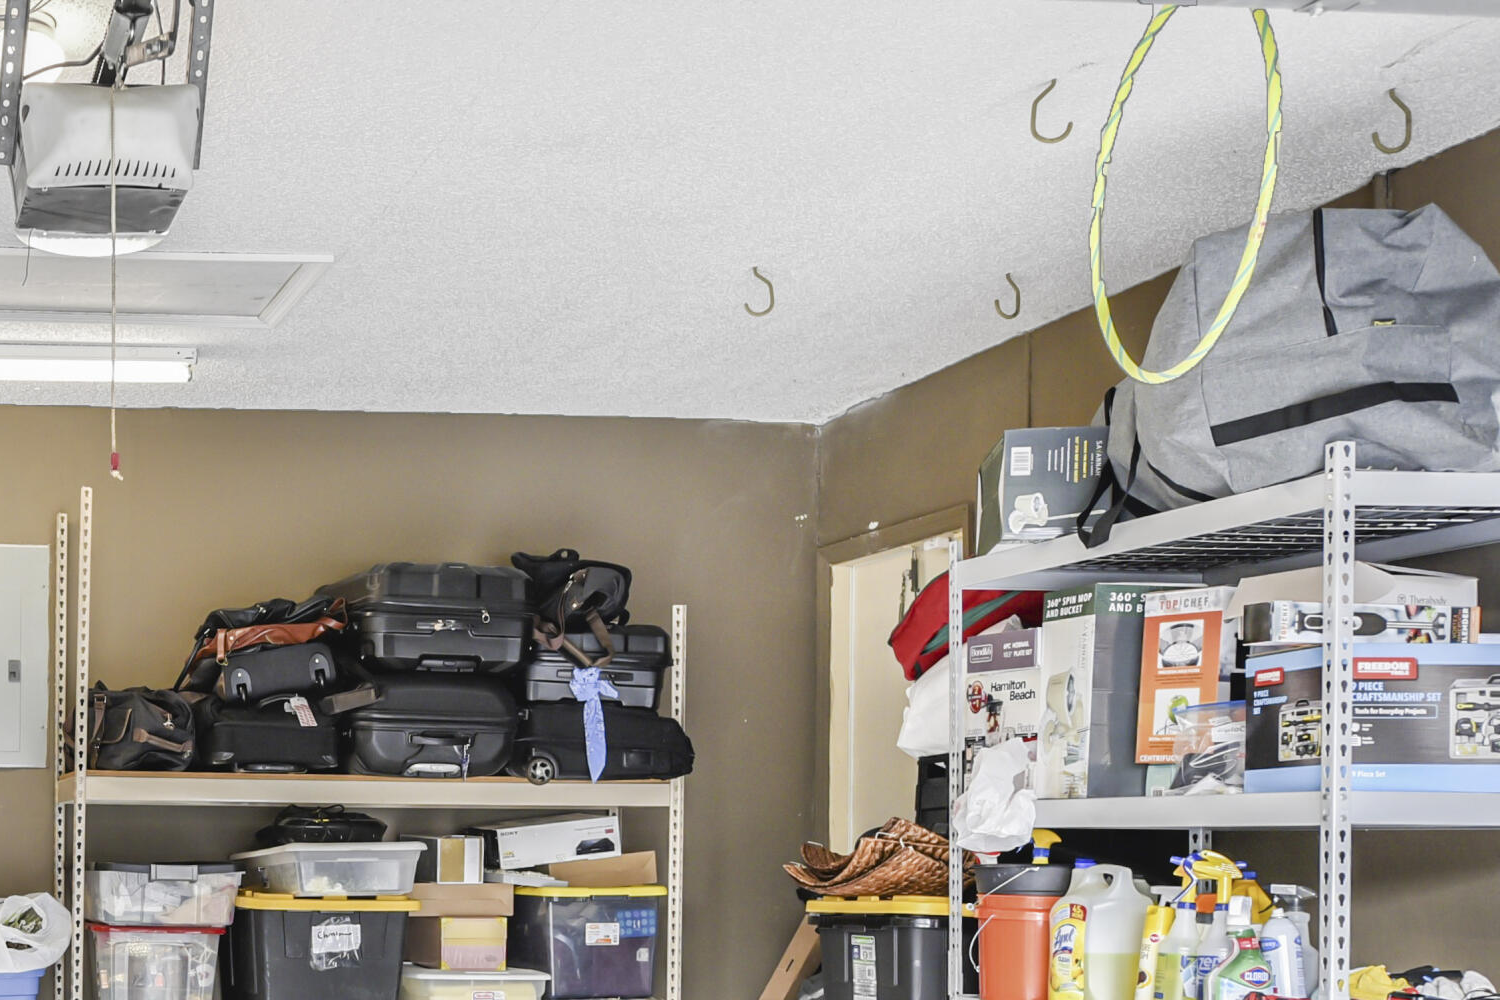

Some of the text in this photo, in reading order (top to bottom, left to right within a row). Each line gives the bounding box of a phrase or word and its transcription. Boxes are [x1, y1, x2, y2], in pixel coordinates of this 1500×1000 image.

[1062, 595, 1077, 606] SPIN
[1078, 592, 1093, 603] MOP
[1109, 592, 1137, 602] 360°
[1409, 594, 1447, 605] Therabody
[1108, 603, 1133, 612] AND
[1159, 596, 1209, 610] TOP CHEF
[1045, 604, 1084, 619] AND BUCKET
[1357, 661, 1411, 673] FREEDOM
[990, 680, 1027, 693] Hamilton
[1358, 682, 1384, 692] PIECE
[1009, 689, 1036, 702] Beach
[1352, 692, 1442, 702] CRAFTSMANSHIP SET
[1354, 707, 1428, 716] Tools for Everyday Projects
